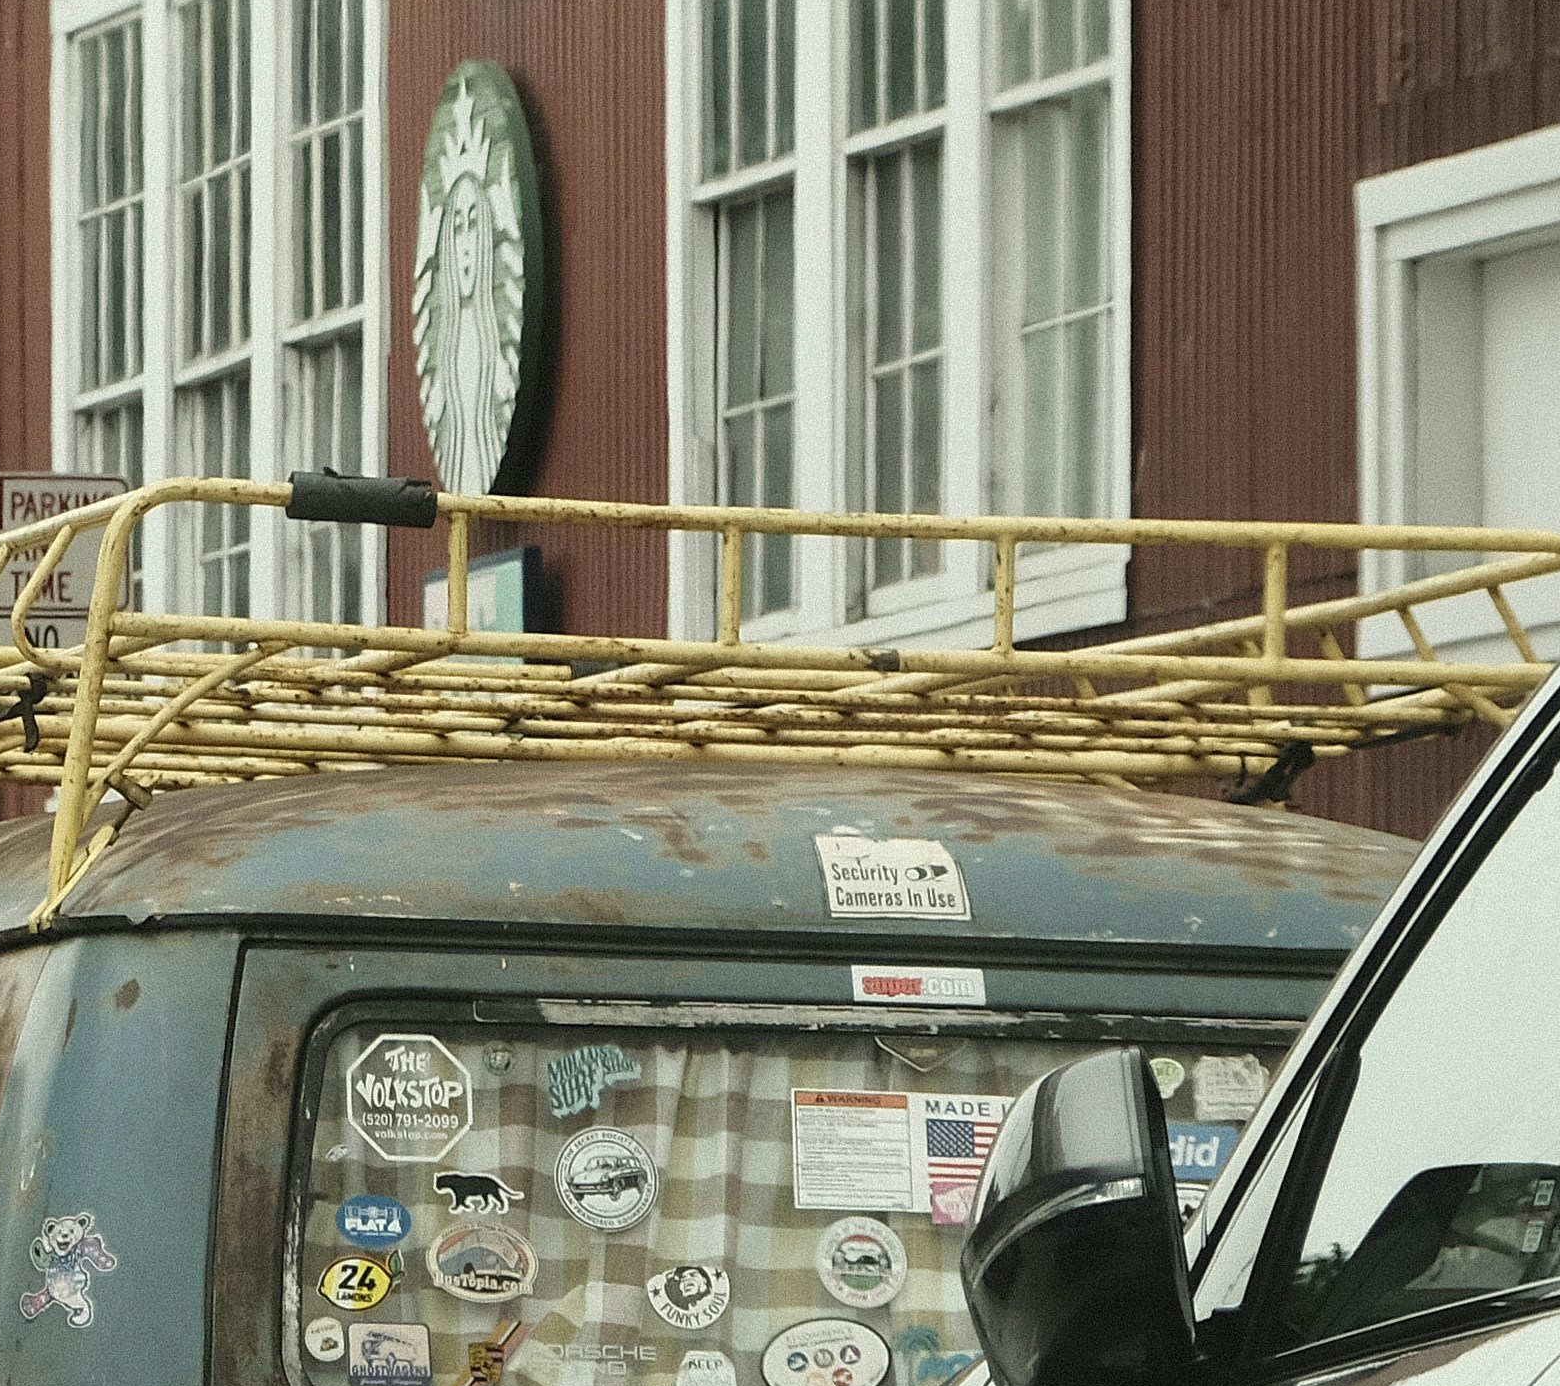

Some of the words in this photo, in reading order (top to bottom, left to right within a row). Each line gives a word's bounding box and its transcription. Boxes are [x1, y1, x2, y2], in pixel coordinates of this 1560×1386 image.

[11, 491, 111, 521] PARKI
[831, 862, 899, 886] Security
[835, 886, 903, 908] Cameras
[906, 888, 923, 908] In
[926, 889, 957, 910] Use
[384, 1045, 429, 1073] THE
[355, 1073, 463, 1109] VOLKSTOP
[549, 1063, 596, 1109] SURF
[362, 1113, 393, 1128] (520)
[925, 1099, 991, 1117] MADE
[344, 1218, 387, 1233] FLAT
[387, 1219, 403, 1234] 4
[337, 1264, 376, 1291] 24
[660, 1301, 702, 1327] FUNKY
[702, 1291, 727, 1321] SOUL
[550, 1344, 658, 1362] ORSCHE
